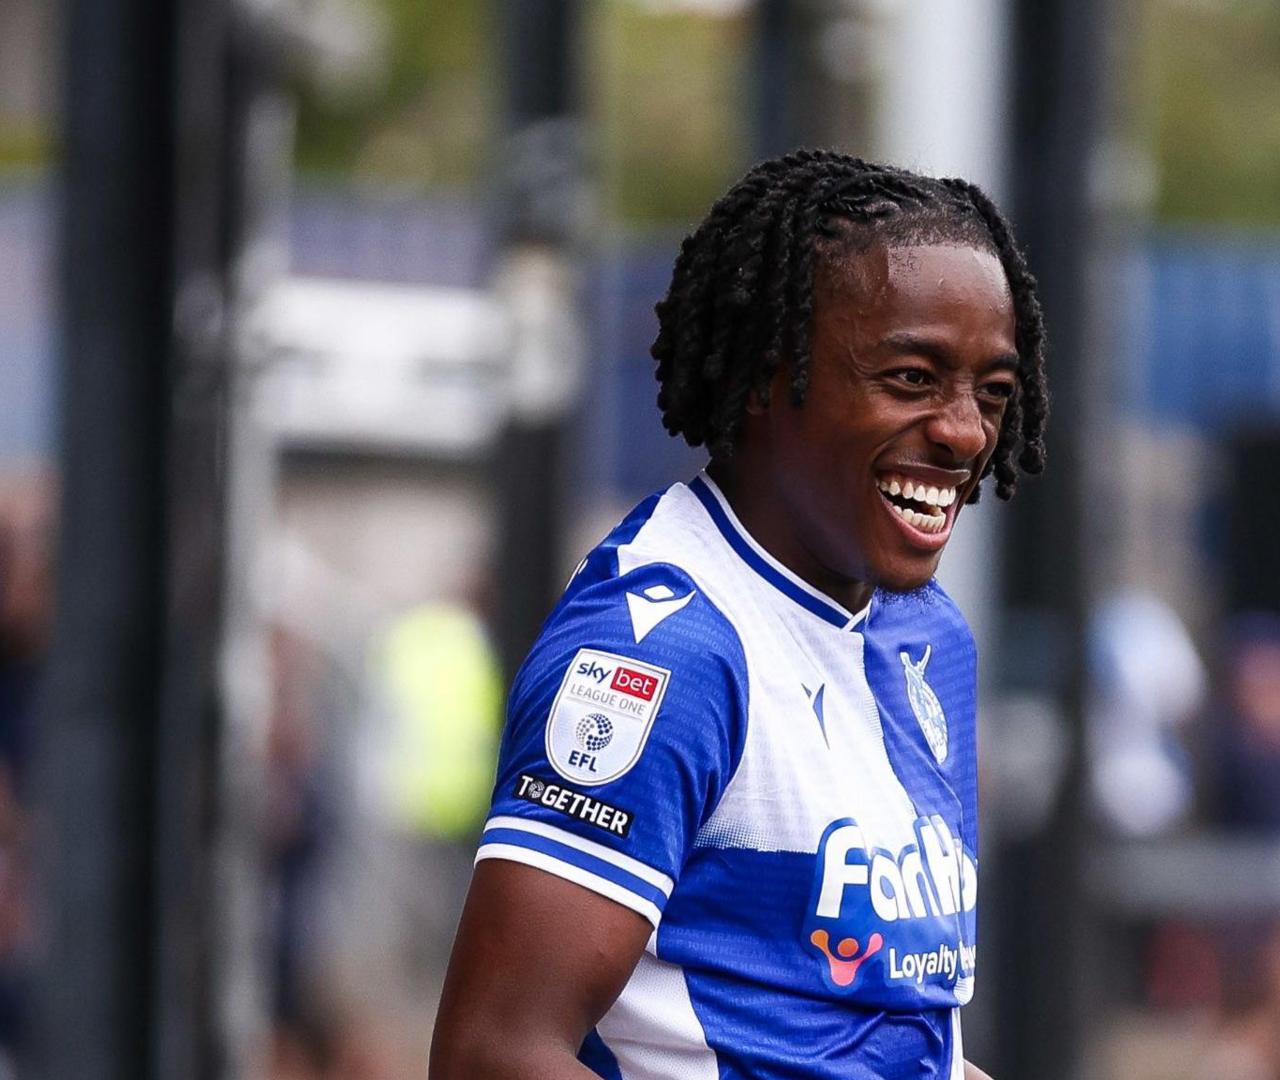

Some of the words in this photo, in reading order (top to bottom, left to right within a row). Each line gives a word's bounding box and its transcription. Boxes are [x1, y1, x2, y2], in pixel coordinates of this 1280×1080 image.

[577, 662, 611, 683] sky
[616, 669, 652, 695] bet
[571, 684, 617, 706] LEAGUE
[620, 698, 645, 715] ONE
[568, 750, 596, 772] EFL
[889, 944, 957, 984] Loyalty
